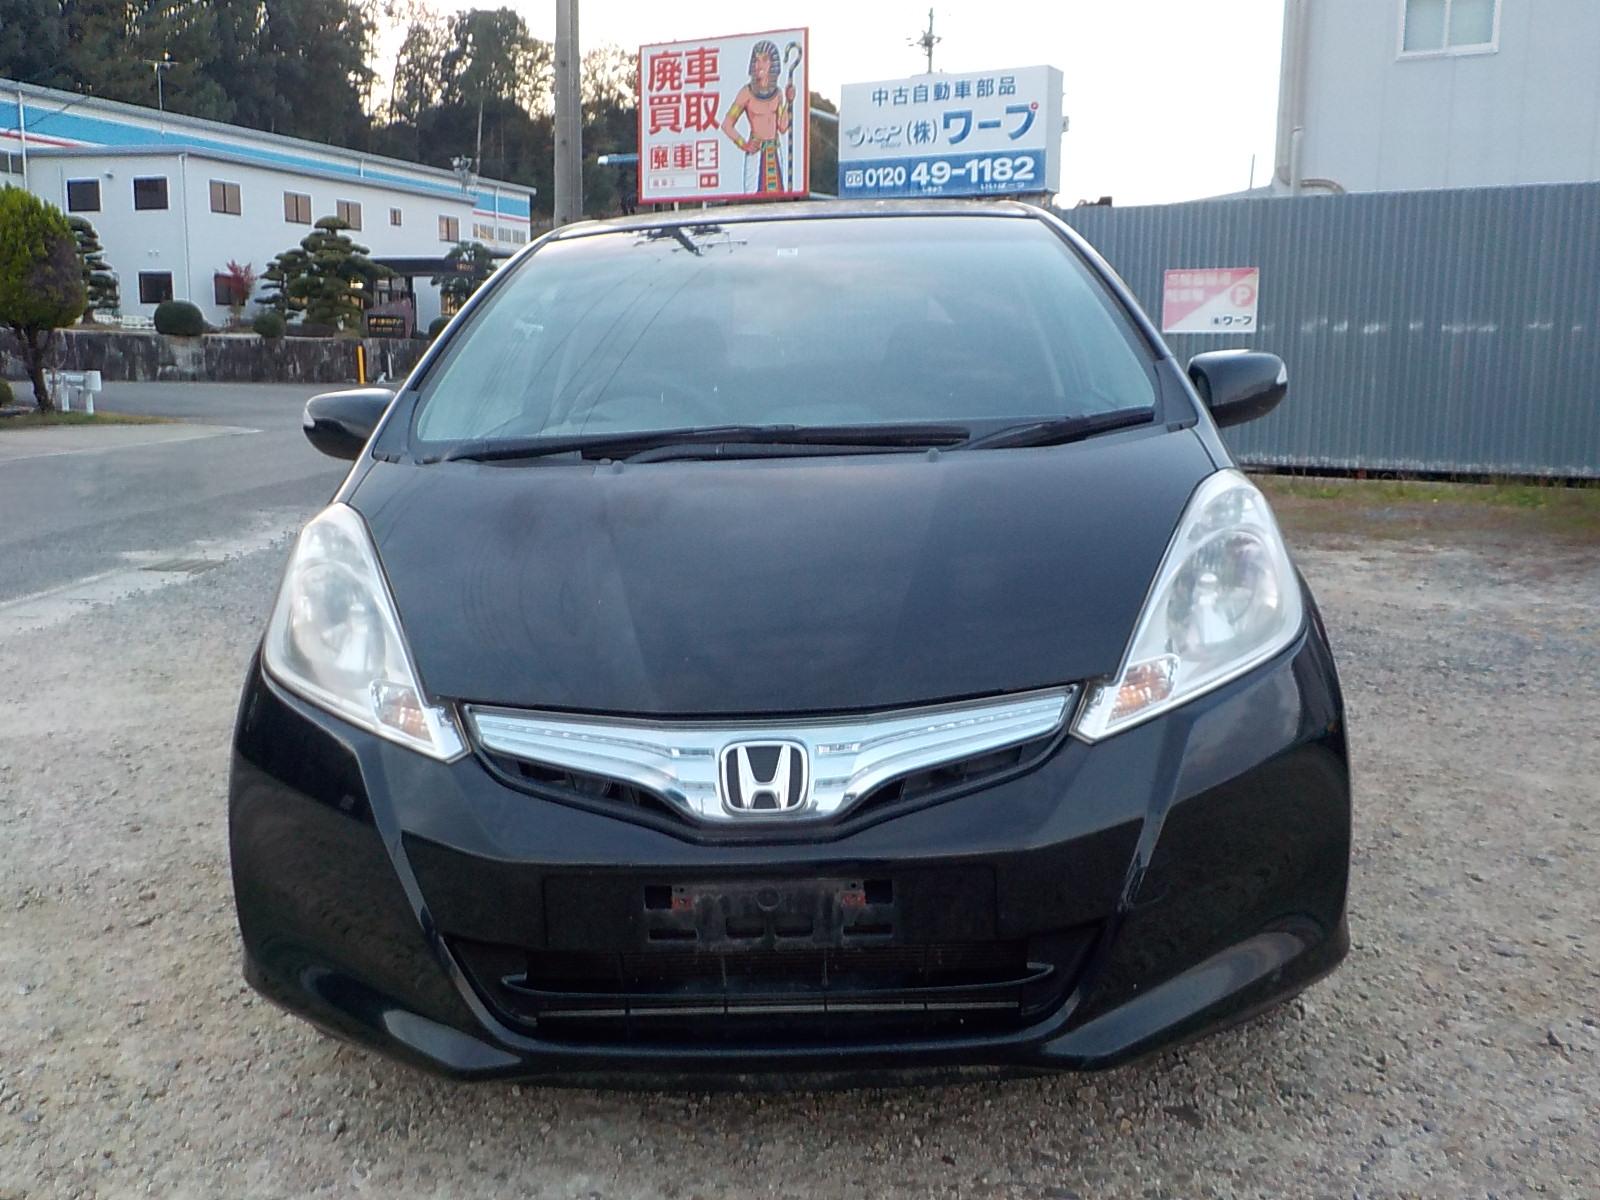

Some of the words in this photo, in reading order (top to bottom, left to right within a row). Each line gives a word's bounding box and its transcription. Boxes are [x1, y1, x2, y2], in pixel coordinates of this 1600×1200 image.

[648, 47, 720, 92] 廃車
[872, 77, 1016, 106] 中古自動車部品
[648, 92, 720, 135] 買取
[865, 166, 906, 187] 0120
[910, 156, 1035, 186] 49-1182
